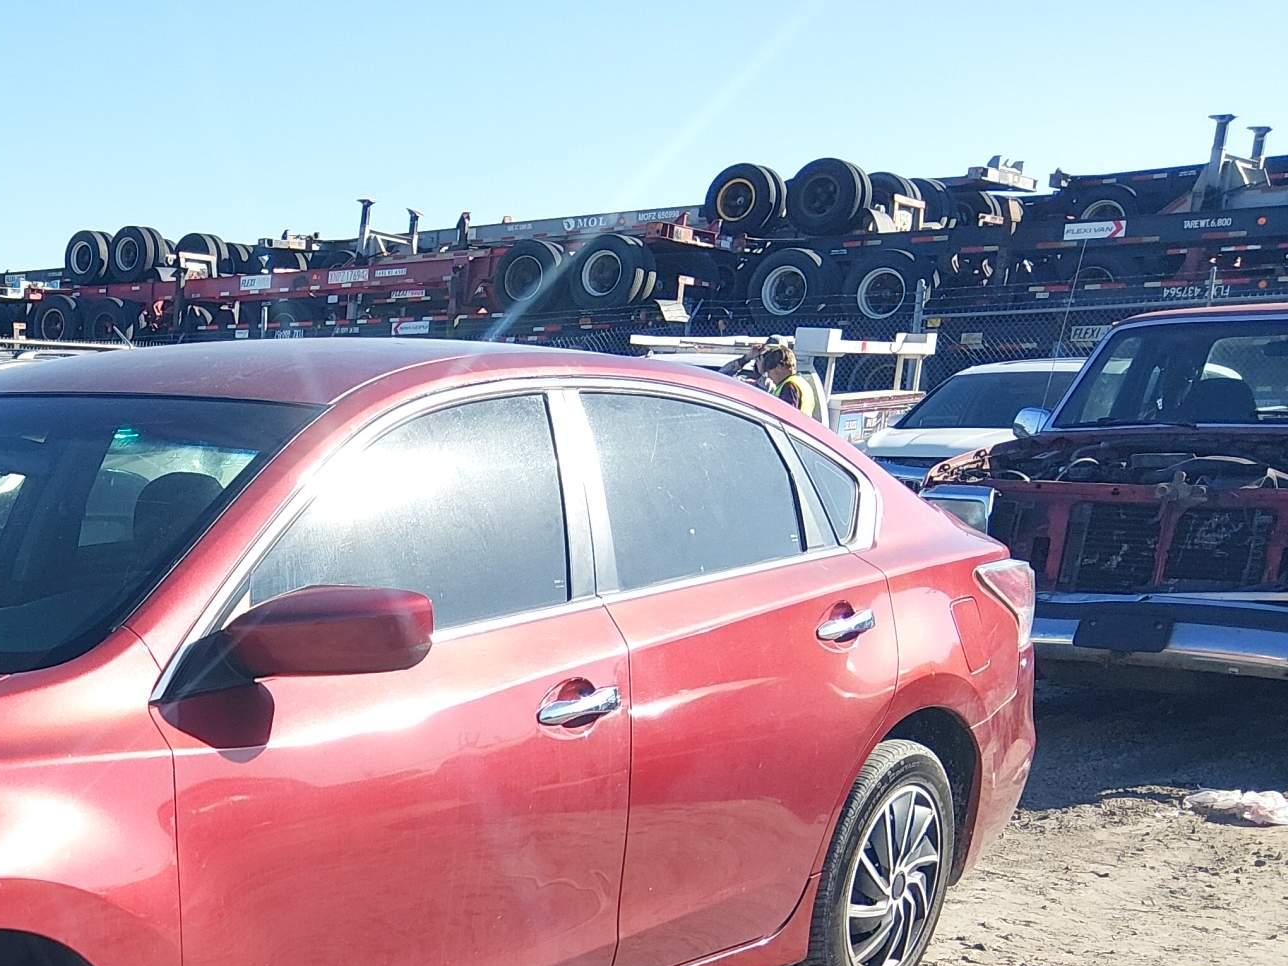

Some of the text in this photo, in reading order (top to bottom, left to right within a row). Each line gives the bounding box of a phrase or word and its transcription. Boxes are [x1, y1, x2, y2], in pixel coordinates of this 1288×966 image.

[576, 216, 608, 230] MOL
[1065, 227, 1093, 235] FLEXI
[1073, 327, 1102, 340] FLEXI
